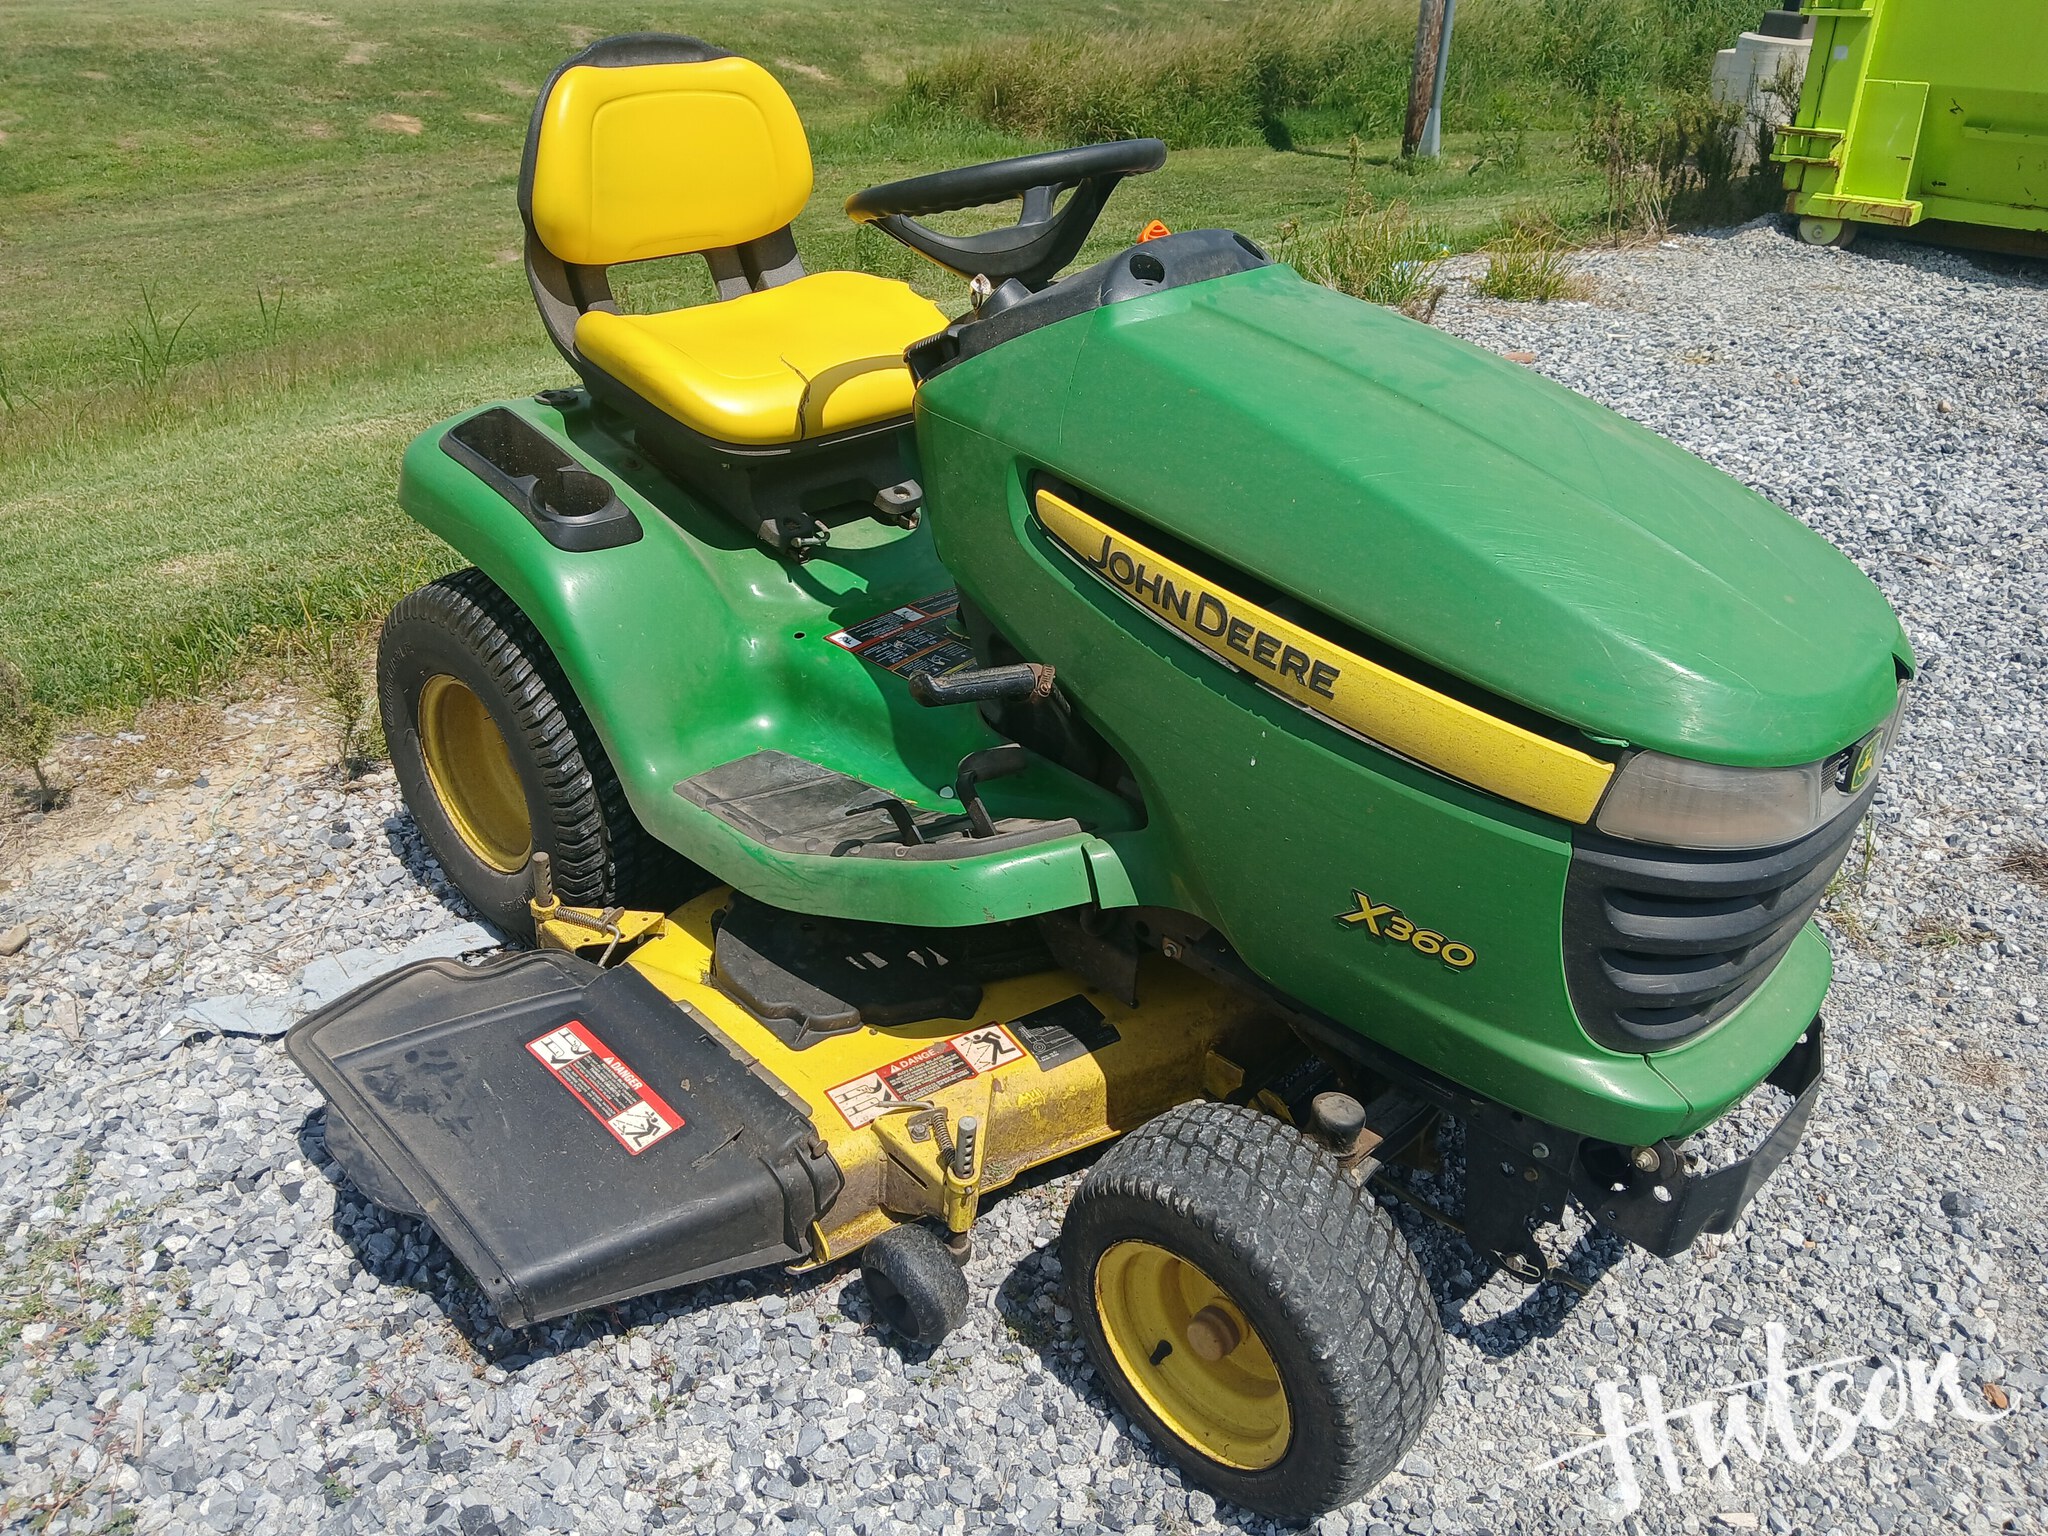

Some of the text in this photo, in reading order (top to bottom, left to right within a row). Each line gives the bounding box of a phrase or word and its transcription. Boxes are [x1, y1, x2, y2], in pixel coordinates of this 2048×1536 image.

[1088, 535, 1341, 700] JOHN DEERE
[1336, 889, 1476, 966] X360
[611, 1062, 643, 1090] DANGER
[899, 1048, 940, 1069] DANGE
